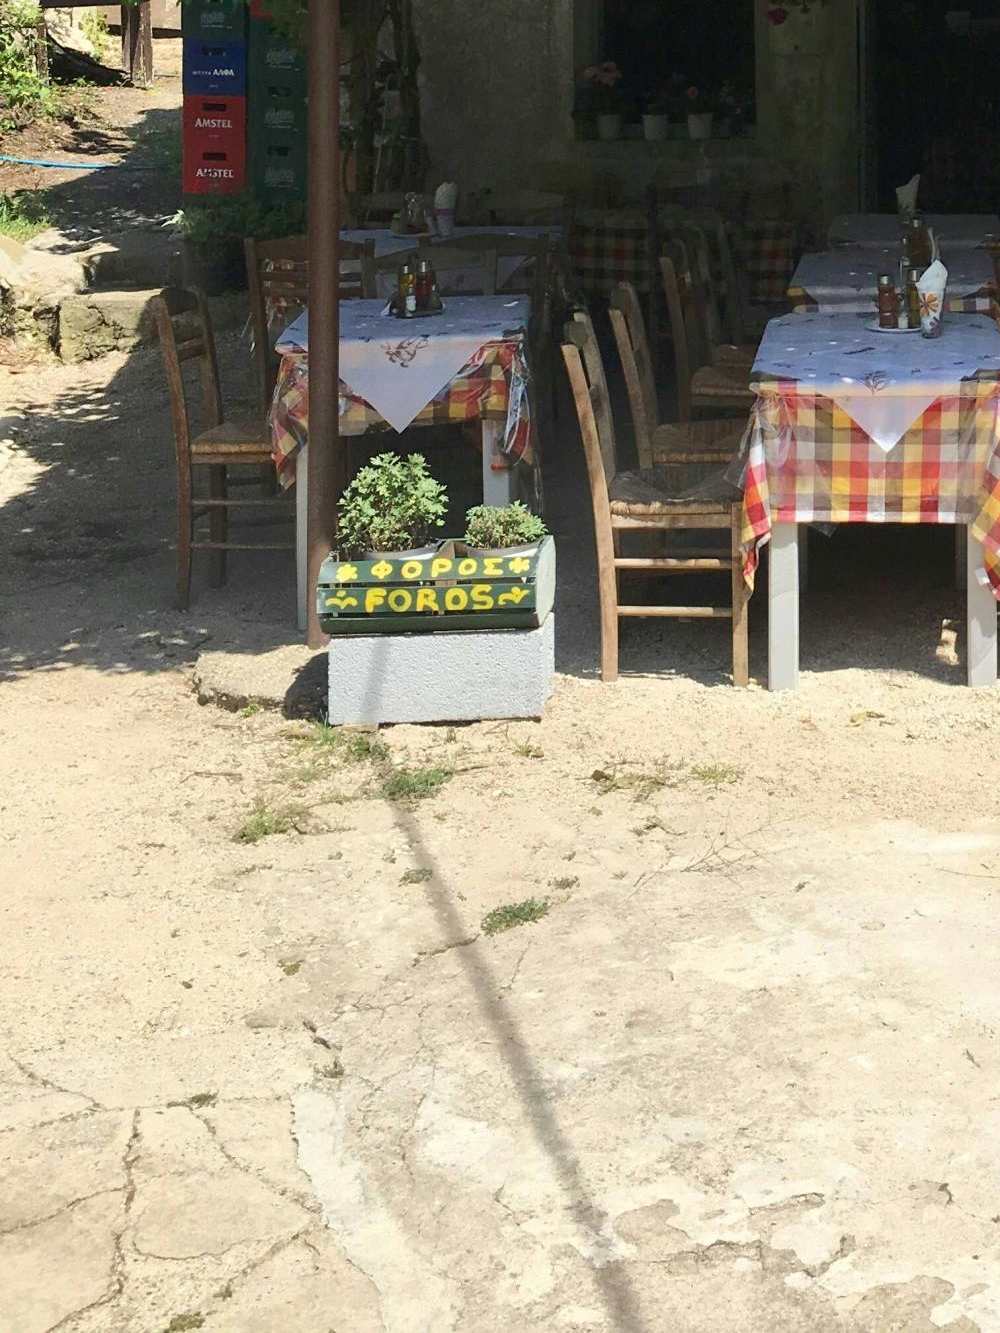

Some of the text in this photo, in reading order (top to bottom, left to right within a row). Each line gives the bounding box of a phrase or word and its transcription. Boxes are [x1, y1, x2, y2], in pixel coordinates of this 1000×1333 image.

[194, 117, 233, 129] AMSTEL
[195, 168, 235, 178] AMSTEL
[371, 557, 504, 579] ΦΟΡΟΣ
[364, 584, 494, 613] FOROS
